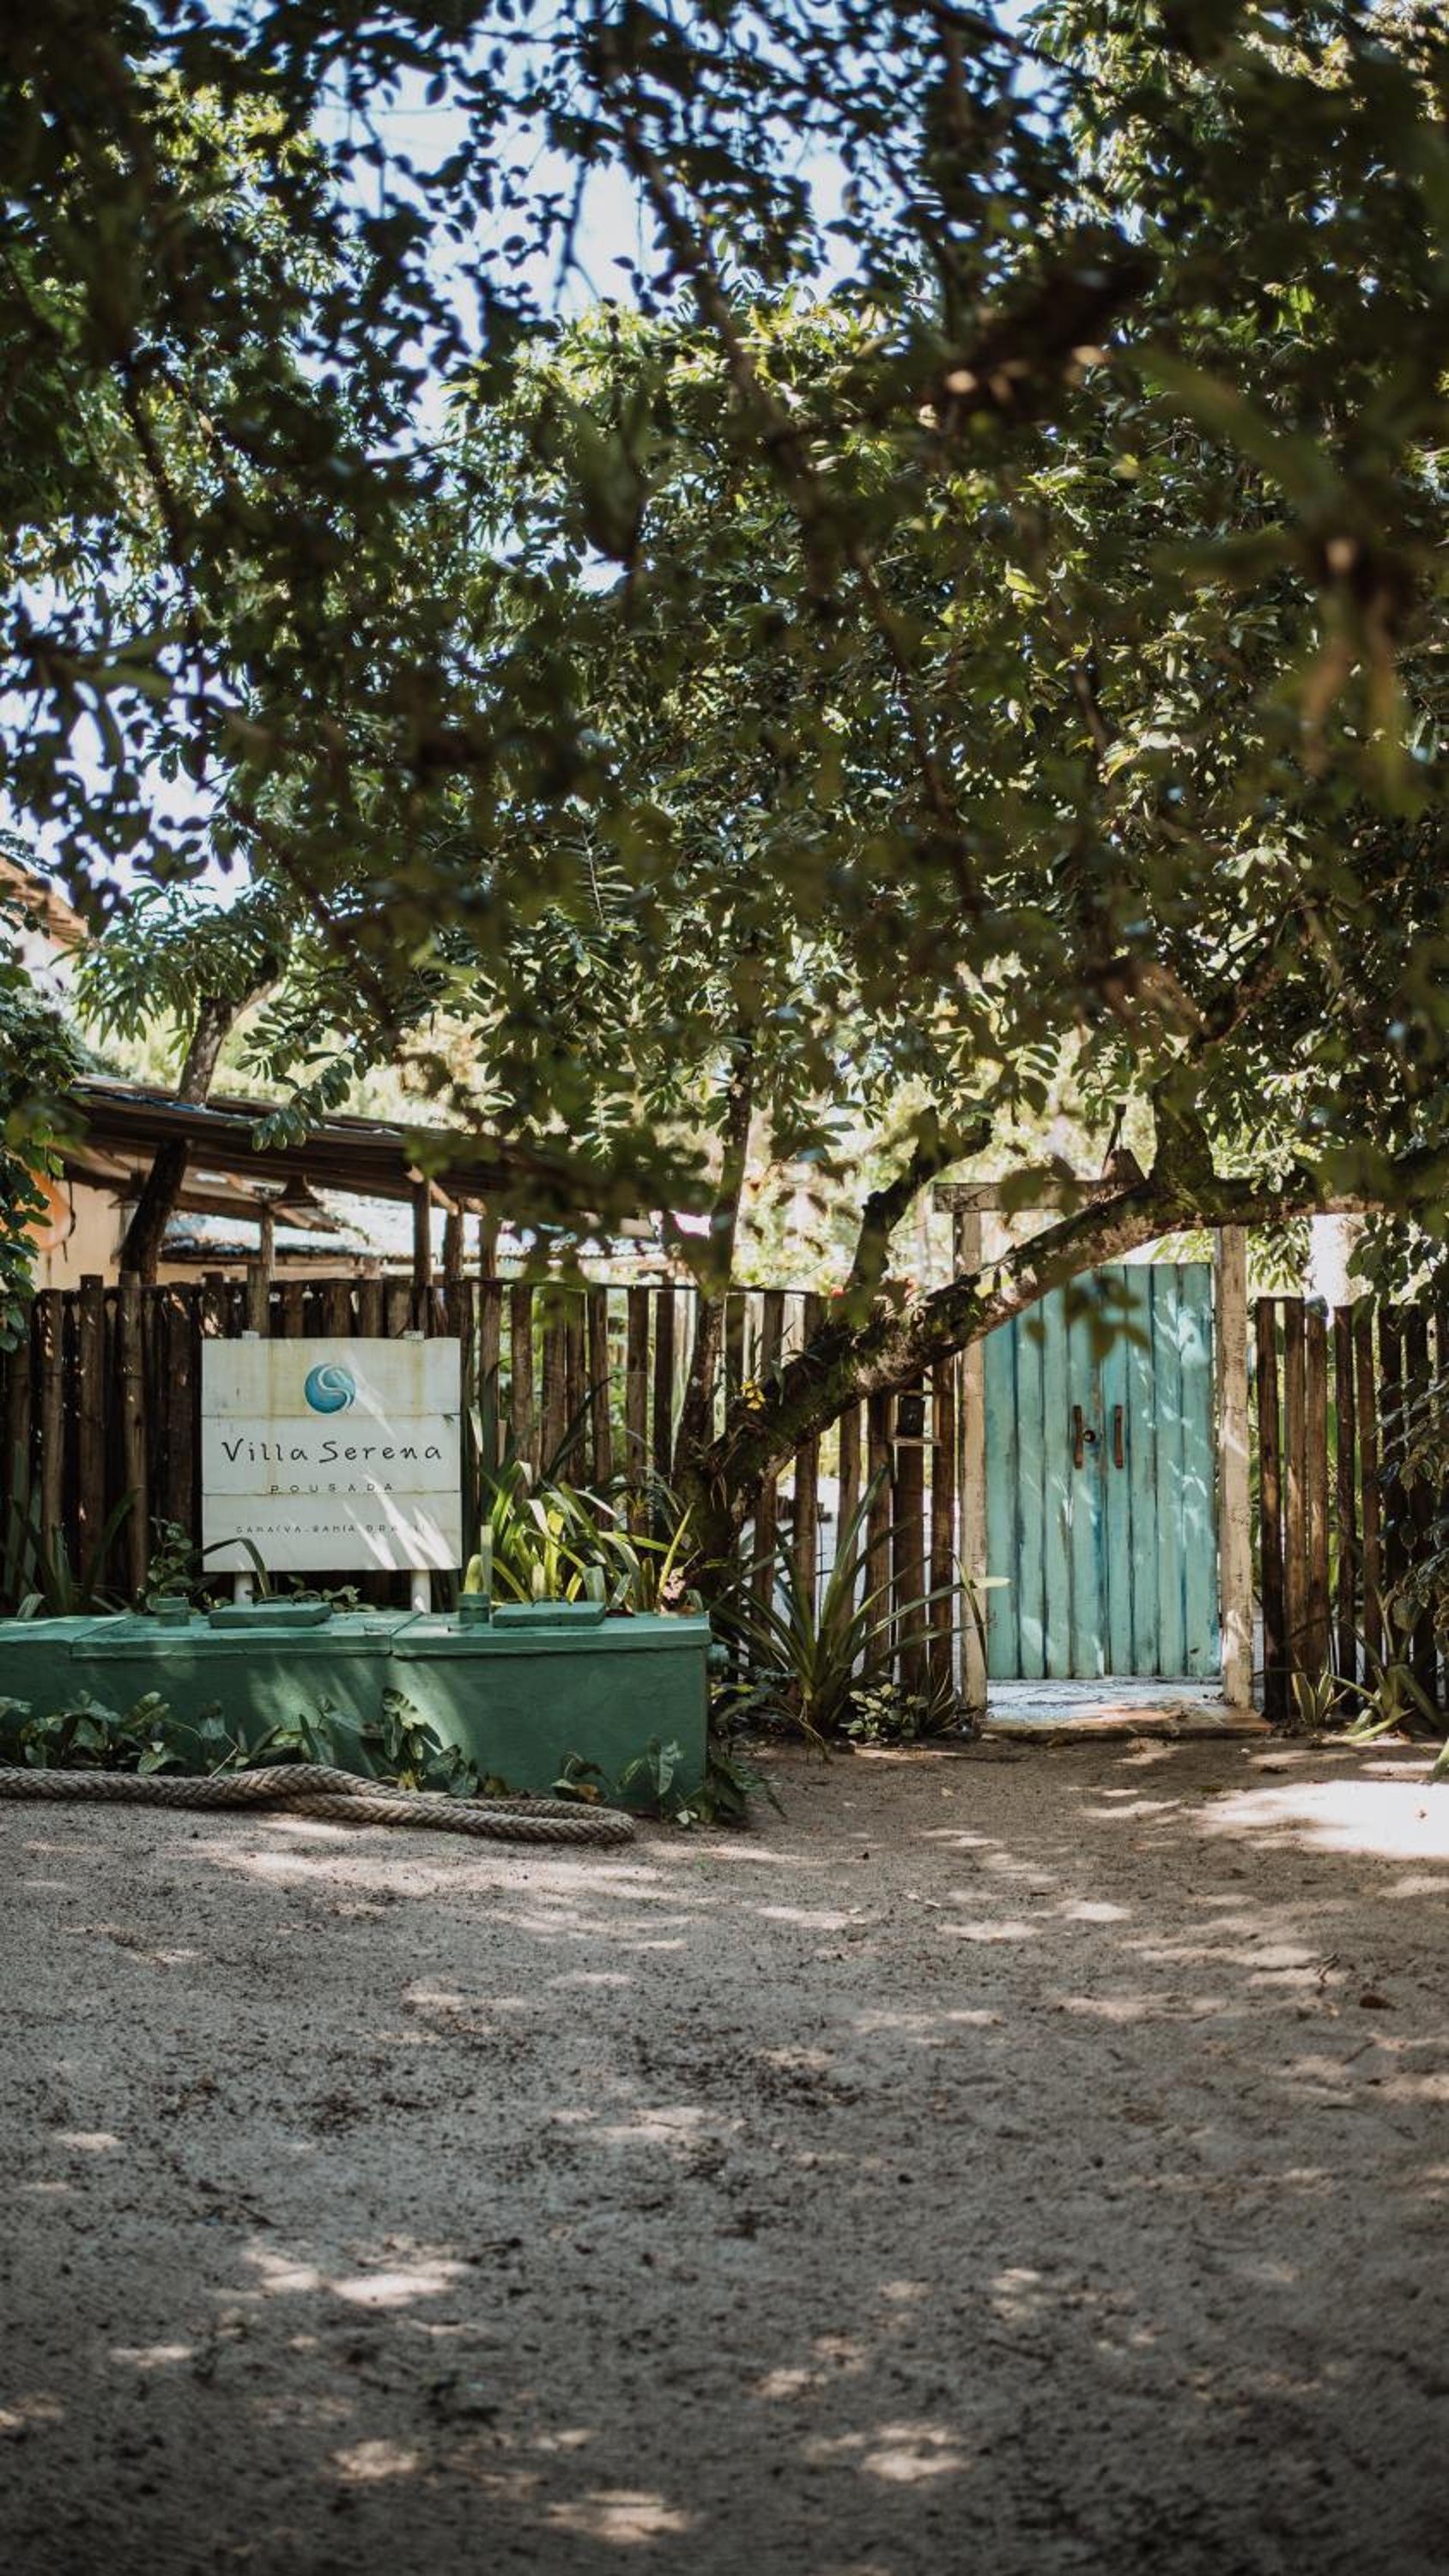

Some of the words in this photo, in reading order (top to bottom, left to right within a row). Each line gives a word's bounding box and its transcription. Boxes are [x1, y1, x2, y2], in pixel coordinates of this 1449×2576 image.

[221, 1439, 307, 1461] Villa
[319, 1441, 442, 1463] Serena
[270, 1483, 393, 1493] POUSADA
